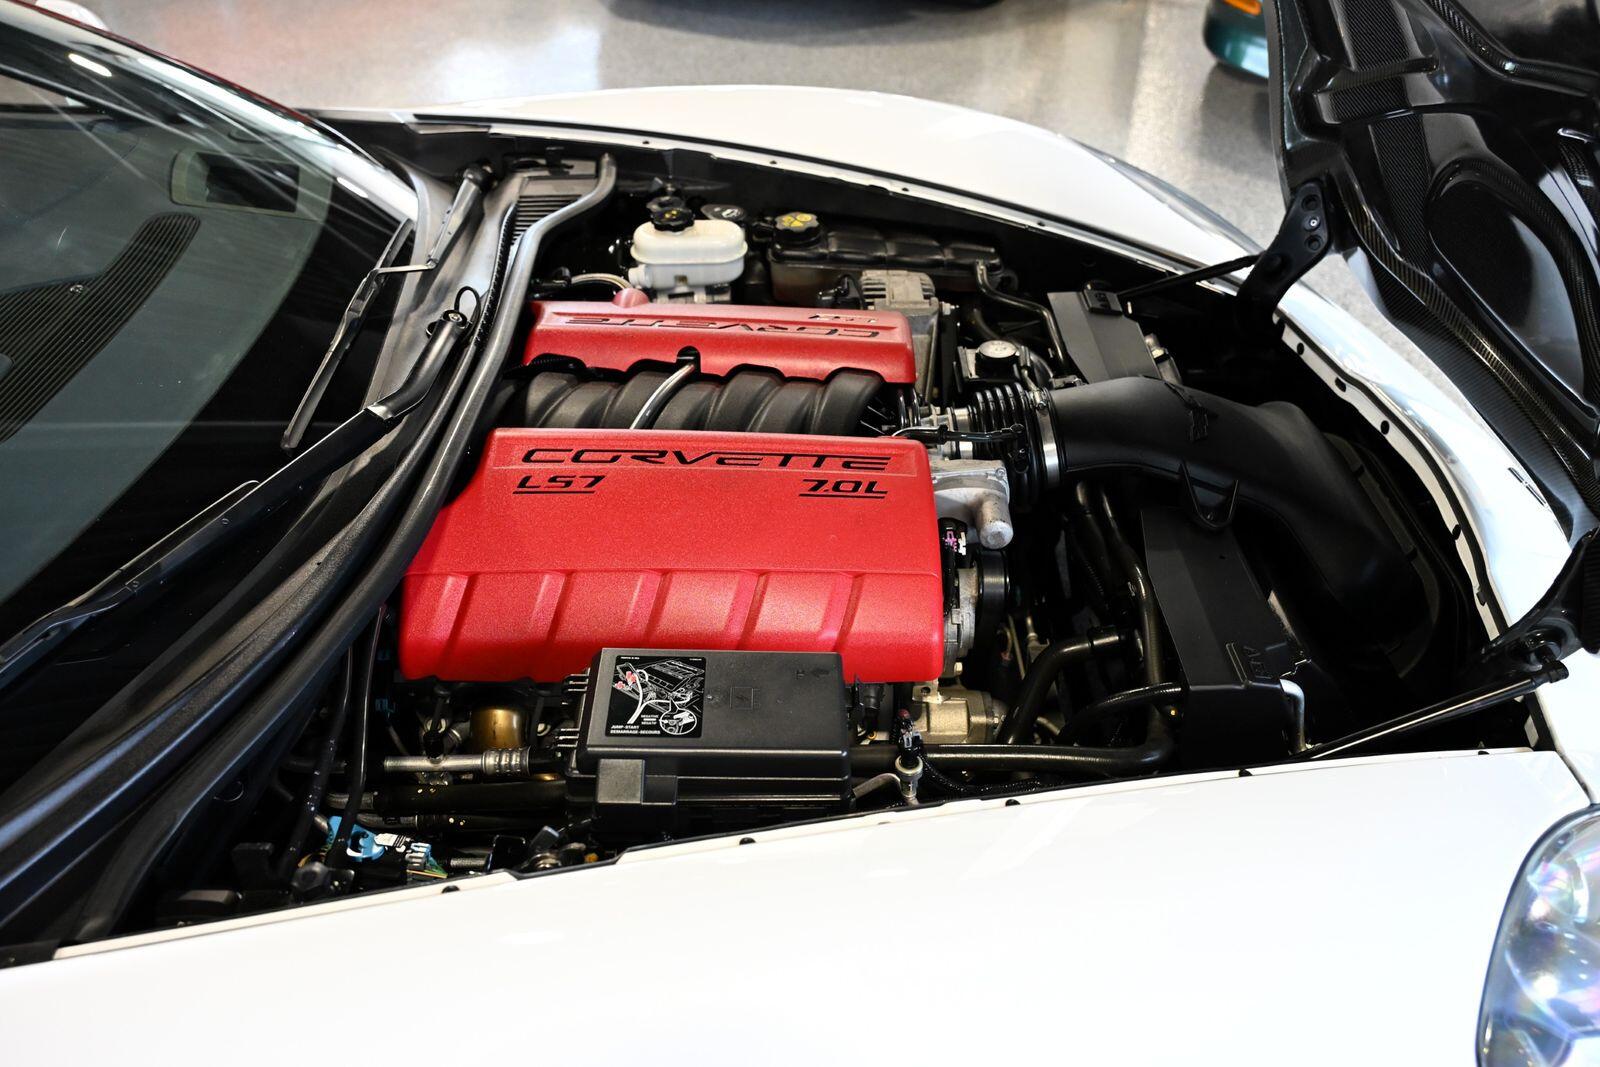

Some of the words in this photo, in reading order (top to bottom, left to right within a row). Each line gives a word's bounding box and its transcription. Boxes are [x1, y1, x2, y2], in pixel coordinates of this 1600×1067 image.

[564, 317, 880, 338] CORVETTE
[521, 449, 892, 471] CORVETTE
[514, 475, 605, 491] LS7
[801, 479, 888, 495] 7.0L
